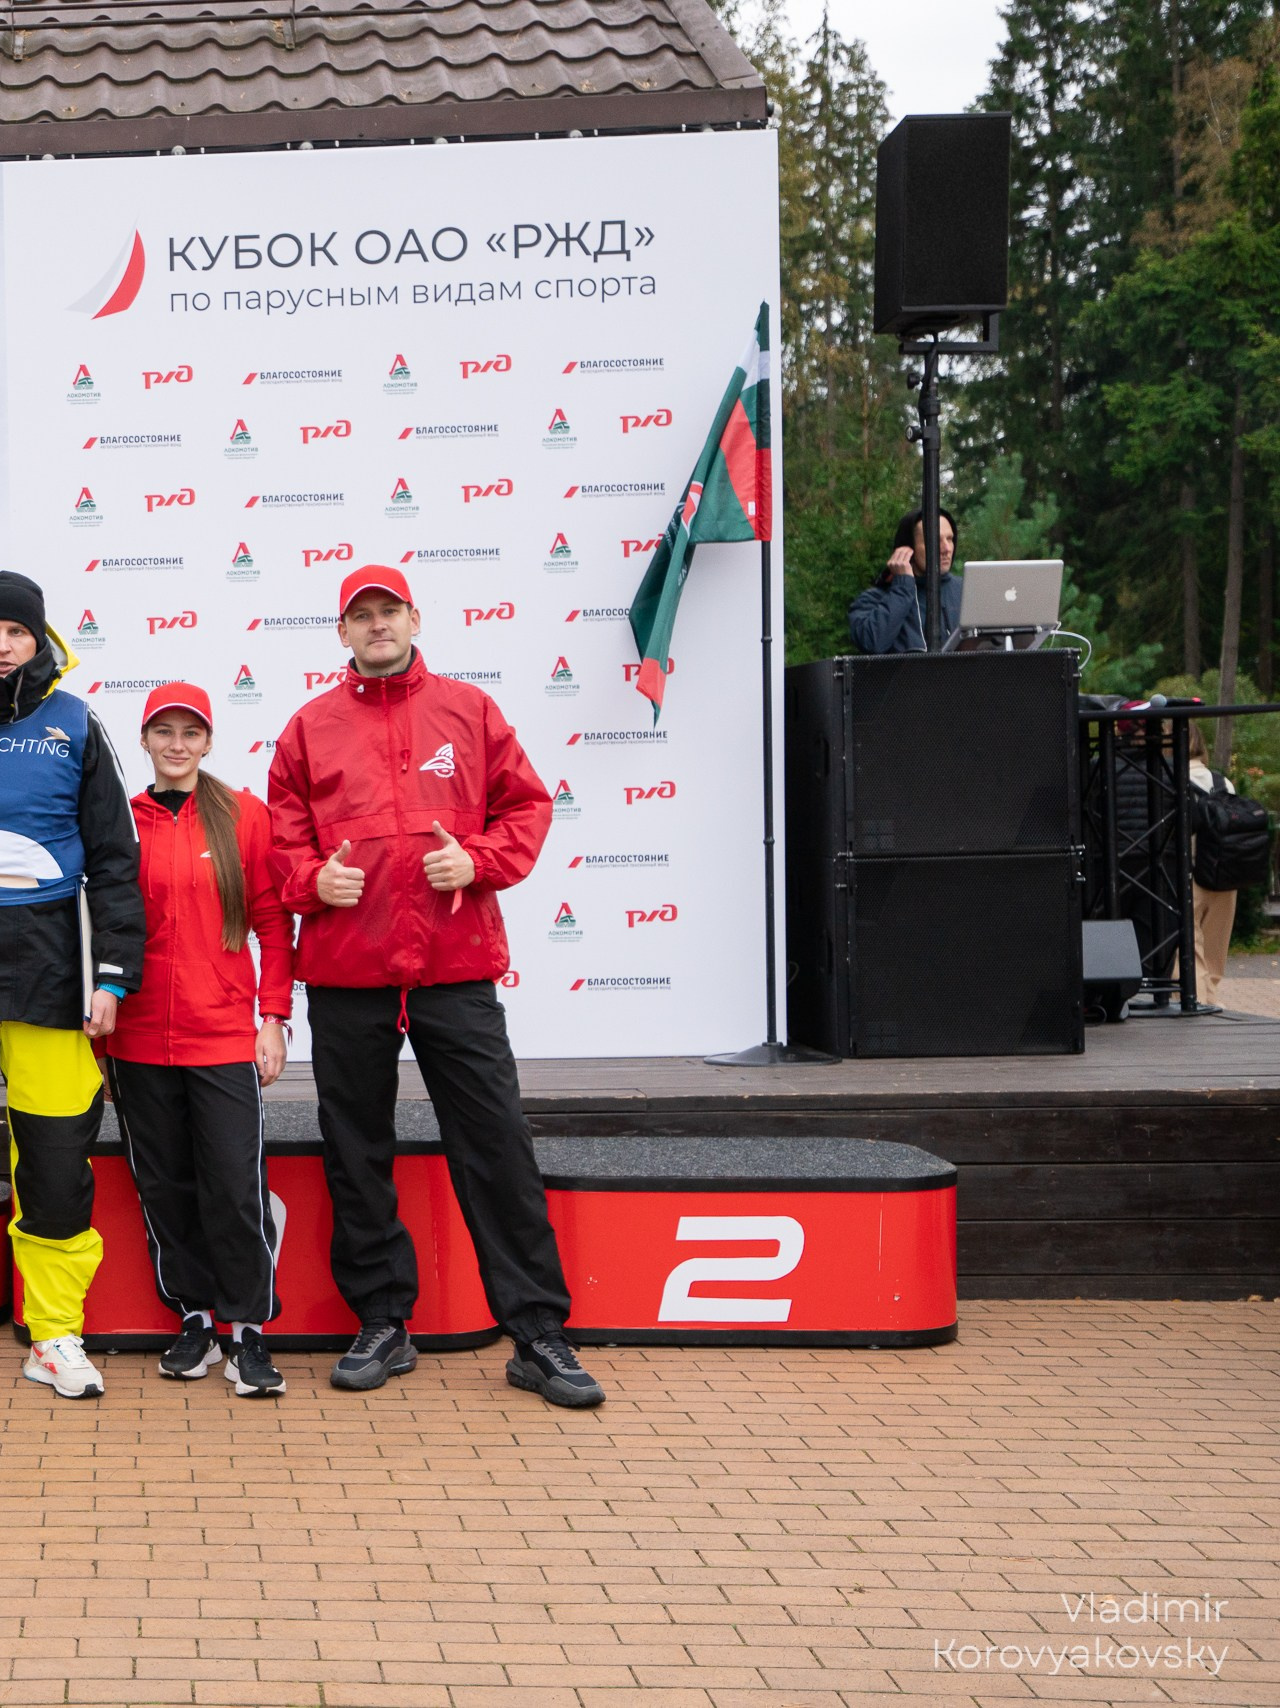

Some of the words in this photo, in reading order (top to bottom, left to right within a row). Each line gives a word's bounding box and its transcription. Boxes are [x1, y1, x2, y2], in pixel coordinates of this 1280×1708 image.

[169, 232, 338, 271] КУБОК
[355, 227, 467, 264] ОАО
[487, 220, 654, 263] «РЖД»
[171, 293, 210, 312] по
[224, 286, 398, 315] парусным
[413, 281, 521, 306] видам
[535, 276, 655, 303] спорта
[580, 358, 664, 369] БЛАГОСОСТОЯНИЕ
[260, 369, 342, 380] БЛАГОСОСТОЯНИЕ
[416, 424, 499, 435] БЛАГОСОСТОЯНИЕ
[100, 434, 182, 444] БЛАГОСОСТОЯНИЕ
[581, 482, 666, 493] БЛАГОСОСТОЯНИЕ
[262, 493, 344, 503] БЛАГОСОСТОЯНИЕ
[417, 548, 500, 558] БЛАГОСОСТОЯНИЕ
[102, 557, 184, 567] БЛАГОСОСТОЯНИЕ
[264, 615, 340, 626] БЛАГОСОСТОЯНИ
[584, 730, 668, 741] БЛАГОСОСТОЯНИЕ
[585, 854, 670, 864] БЛАГОСОСТОЯНИЕ
[587, 977, 672, 986] БЛАГОСОСТОЯНИЕ
[658, 1216, 805, 1323] 2
